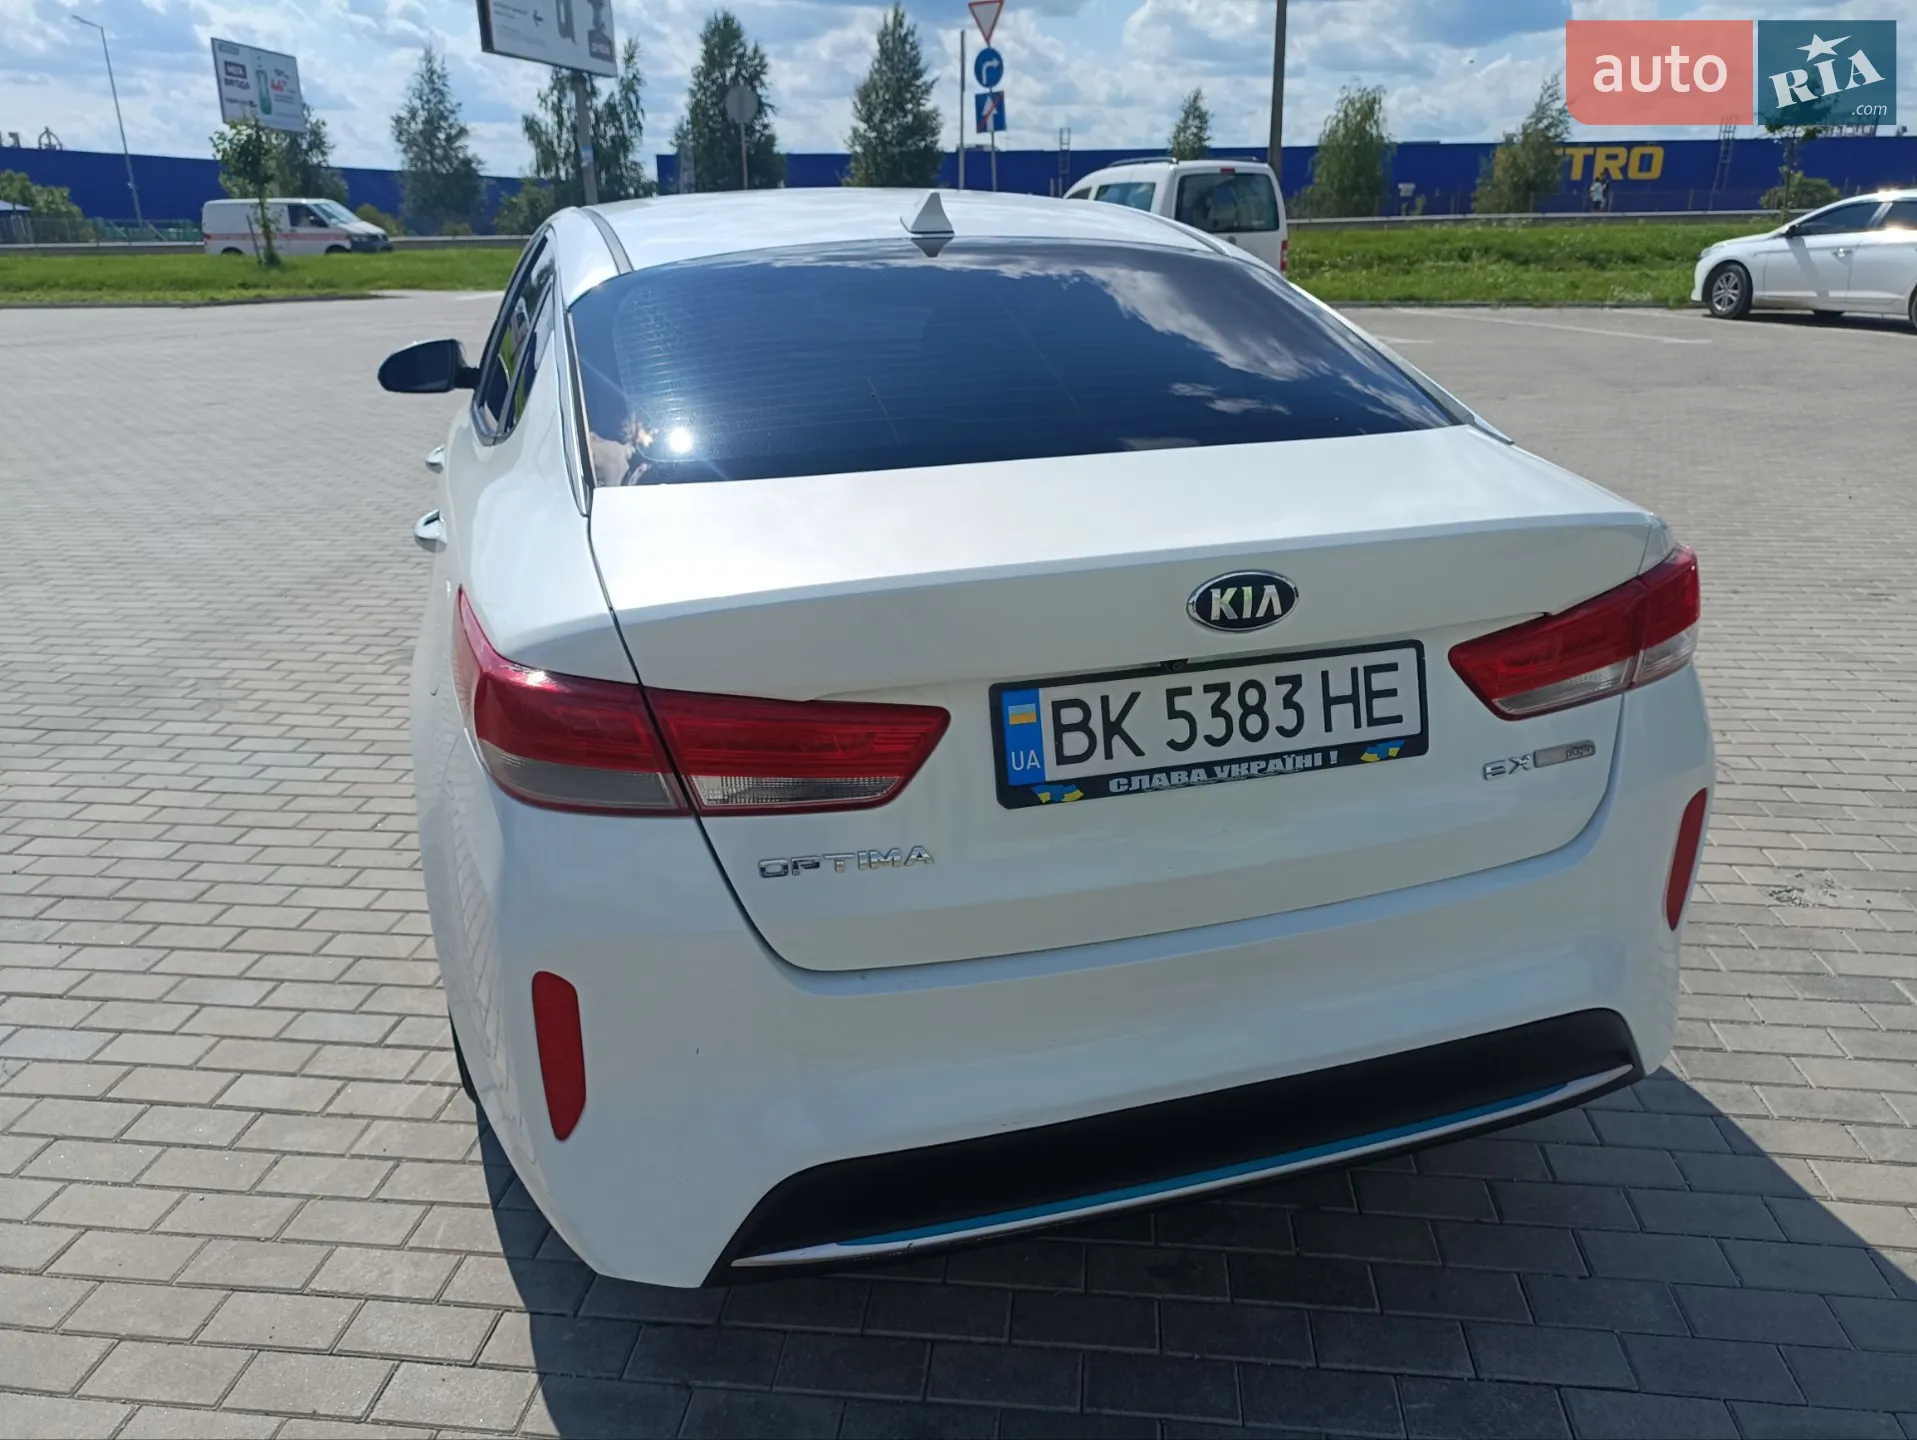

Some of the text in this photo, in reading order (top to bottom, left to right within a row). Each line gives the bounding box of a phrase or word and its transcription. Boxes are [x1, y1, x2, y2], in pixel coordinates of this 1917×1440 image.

[1210, 585, 1283, 621] KIA
[1051, 662, 1404, 766] BK 5383 HE
[1011, 749, 1042, 771] UA
[1108, 767, 1208, 794] СЛАВА
[1213, 752, 1323, 780] УКРАЇНІ
[1483, 753, 1532, 781] EX
[758, 845, 935, 878] OPTIMA
